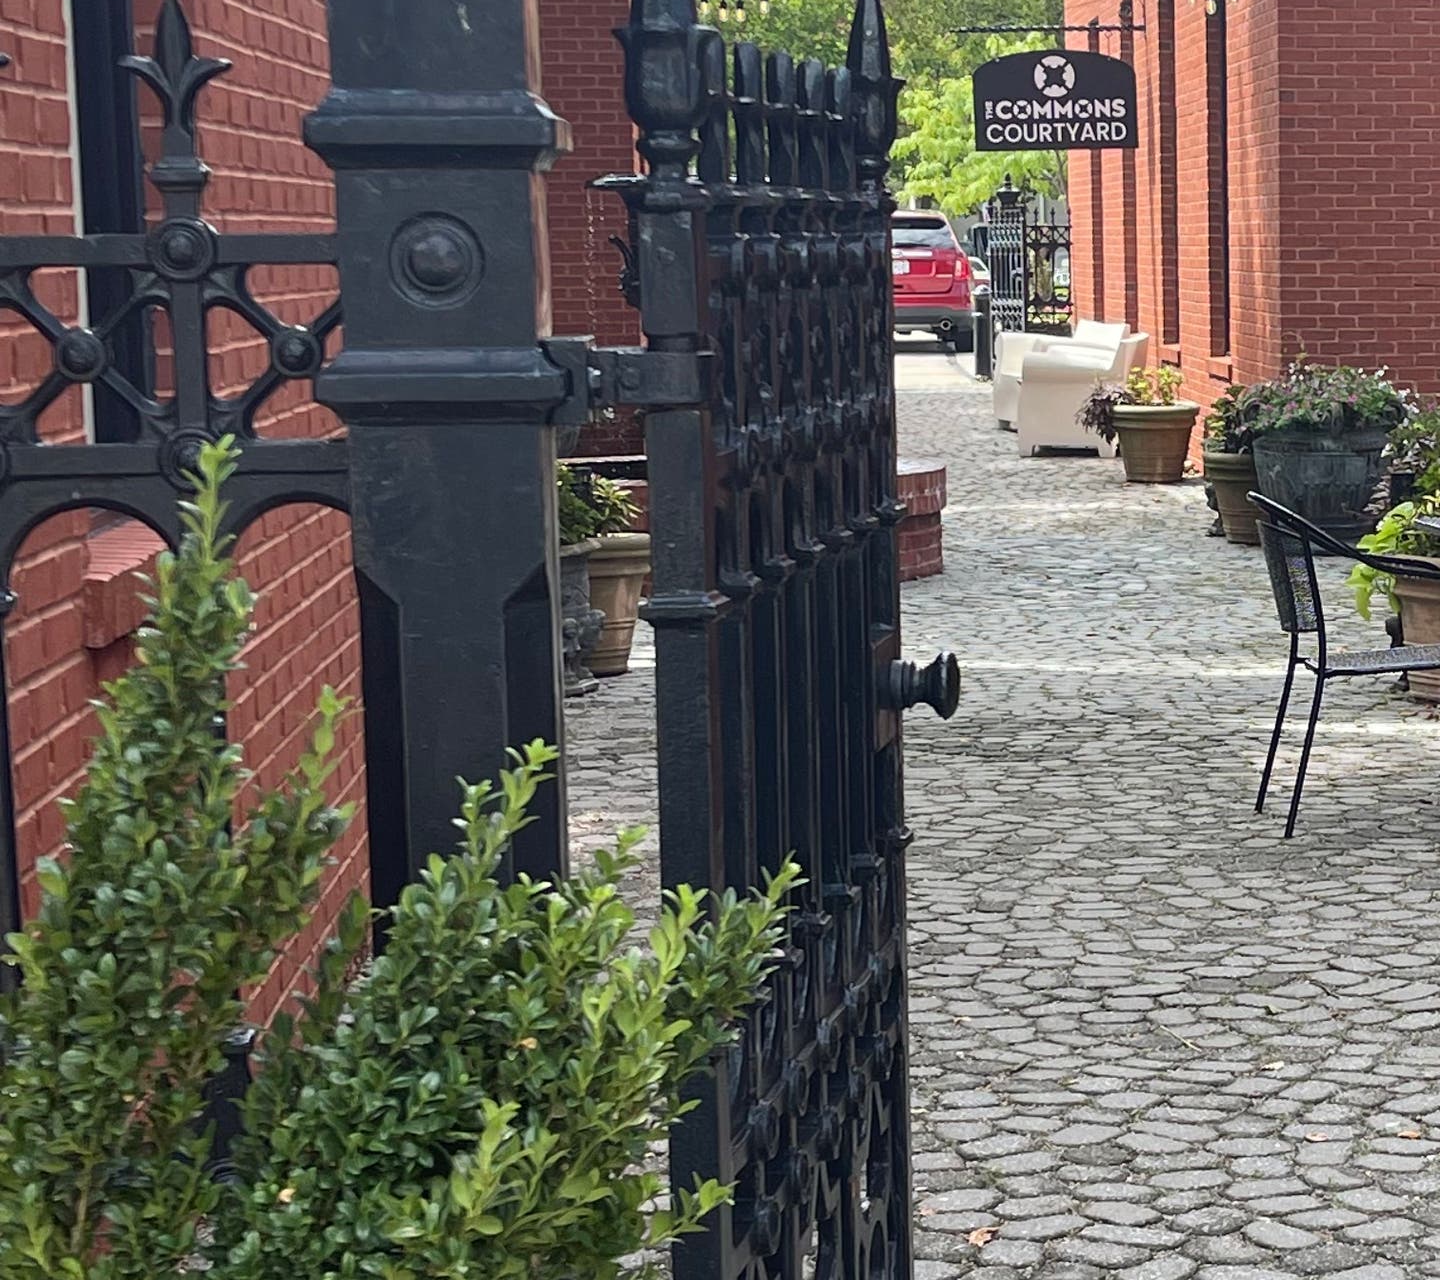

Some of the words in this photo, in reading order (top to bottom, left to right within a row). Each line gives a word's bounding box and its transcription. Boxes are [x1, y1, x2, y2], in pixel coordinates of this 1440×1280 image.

[985, 100, 994, 120] THE
[995, 98, 1127, 120] COMMONS
[986, 122, 1127, 144] COURTYARD
